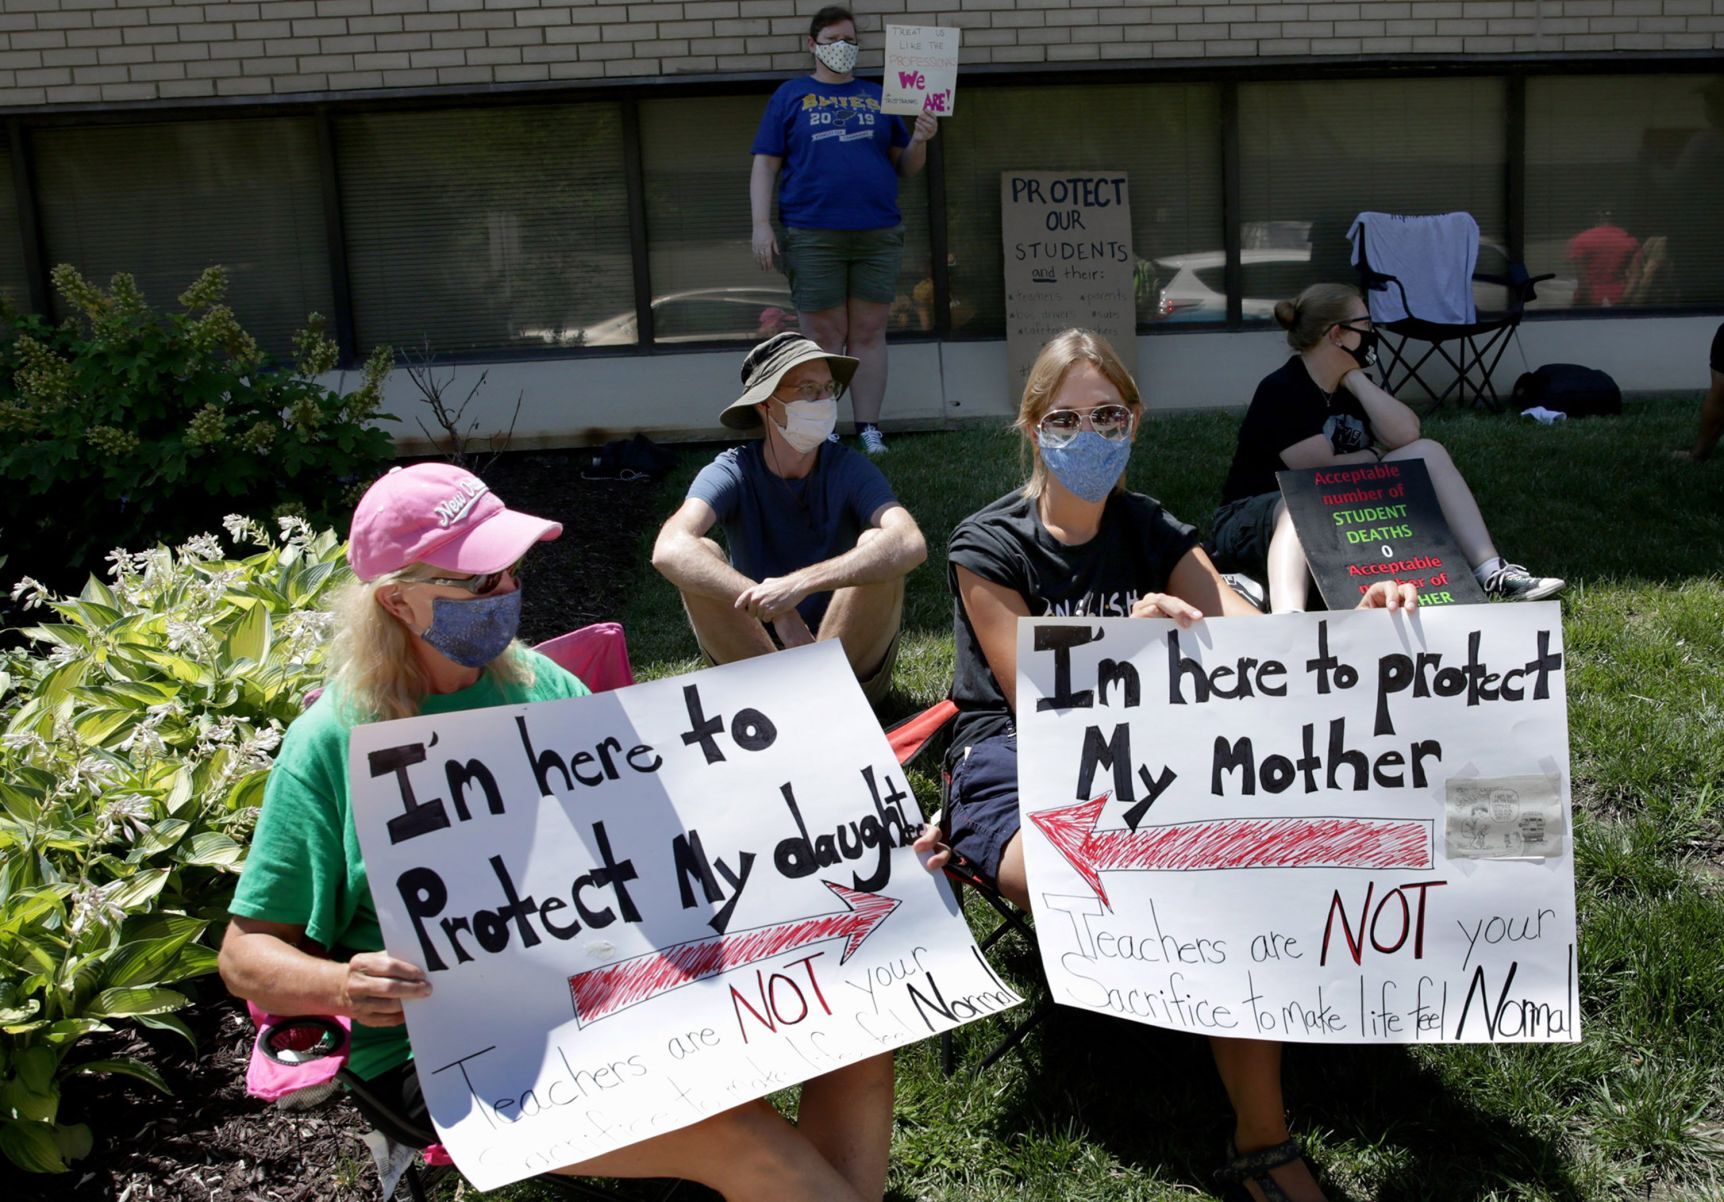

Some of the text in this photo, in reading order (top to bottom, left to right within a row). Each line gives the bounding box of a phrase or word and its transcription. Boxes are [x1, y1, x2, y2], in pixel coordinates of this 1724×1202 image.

[891, 27, 945, 37] TREAT US
[899, 41, 944, 50] LIKE THE
[898, 71, 926, 90] We
[924, 89, 951, 112] ARE!
[810, 112, 875, 126] 20 19
[1012, 178, 1126, 207] PROTECT
[1046, 210, 1085, 231] OUR
[1015, 242, 1128, 262] STUDENTS
[1032, 265, 1104, 280] and their:
[1314, 464, 1400, 485] Acceptable
[1323, 482, 1405, 505] number of
[434, 490, 466, 527] New
[1332, 504, 1407, 525] STUDENT
[1346, 524, 1412, 544] DEATHS
[1349, 556, 1442, 576] Acceptable
[1359, 573, 1448, 594] nber of
[1034, 620, 1562, 737] I'm here to protect
[367, 684, 777, 845] I'm here to
[1076, 722, 1178, 833] My
[397, 820, 643, 972] Protect
[672, 829, 757, 935] My
[1042, 881, 1555, 972] Teachers are NOT your
[906, 944, 1026, 1032] Normal
[1061, 952, 1239, 1028] Sacrifice
[1242, 970, 1276, 1034] to
[1360, 974, 1403, 1038] life
[1408, 976, 1447, 1040] feel
[1455, 943, 1573, 1041] Normal
[432, 946, 927, 1130] Teachers are NOT your
